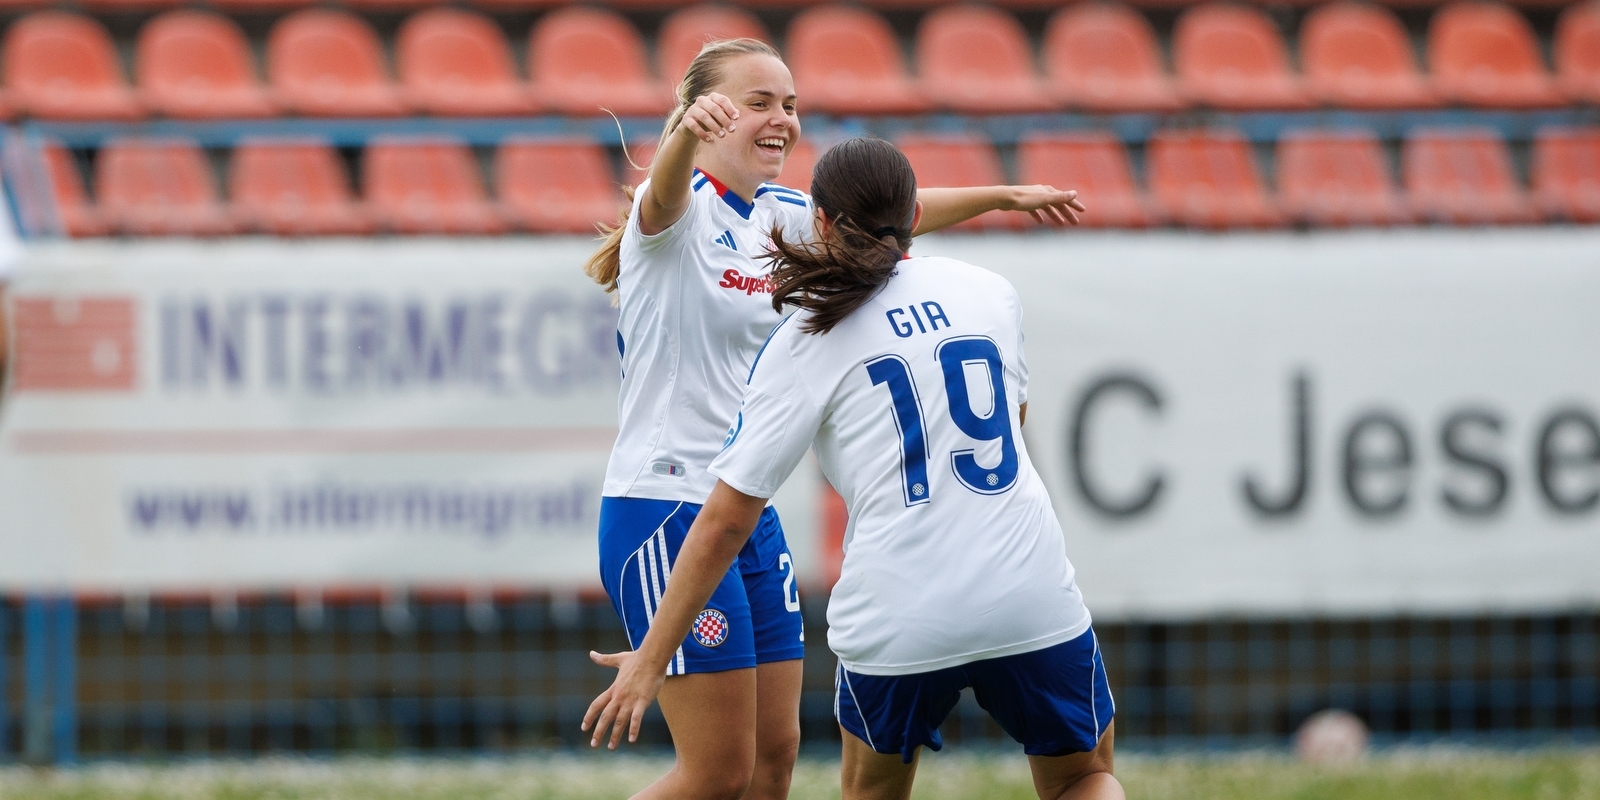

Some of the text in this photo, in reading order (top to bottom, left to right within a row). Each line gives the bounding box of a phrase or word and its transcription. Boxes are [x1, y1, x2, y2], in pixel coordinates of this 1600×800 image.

[886, 301, 951, 338] GIA
[864, 335, 1020, 507] 19
[1070, 370, 1600, 519] C Jese
[694, 610, 724, 625] HAJDUK
[700, 635, 723, 646] SPLIT
